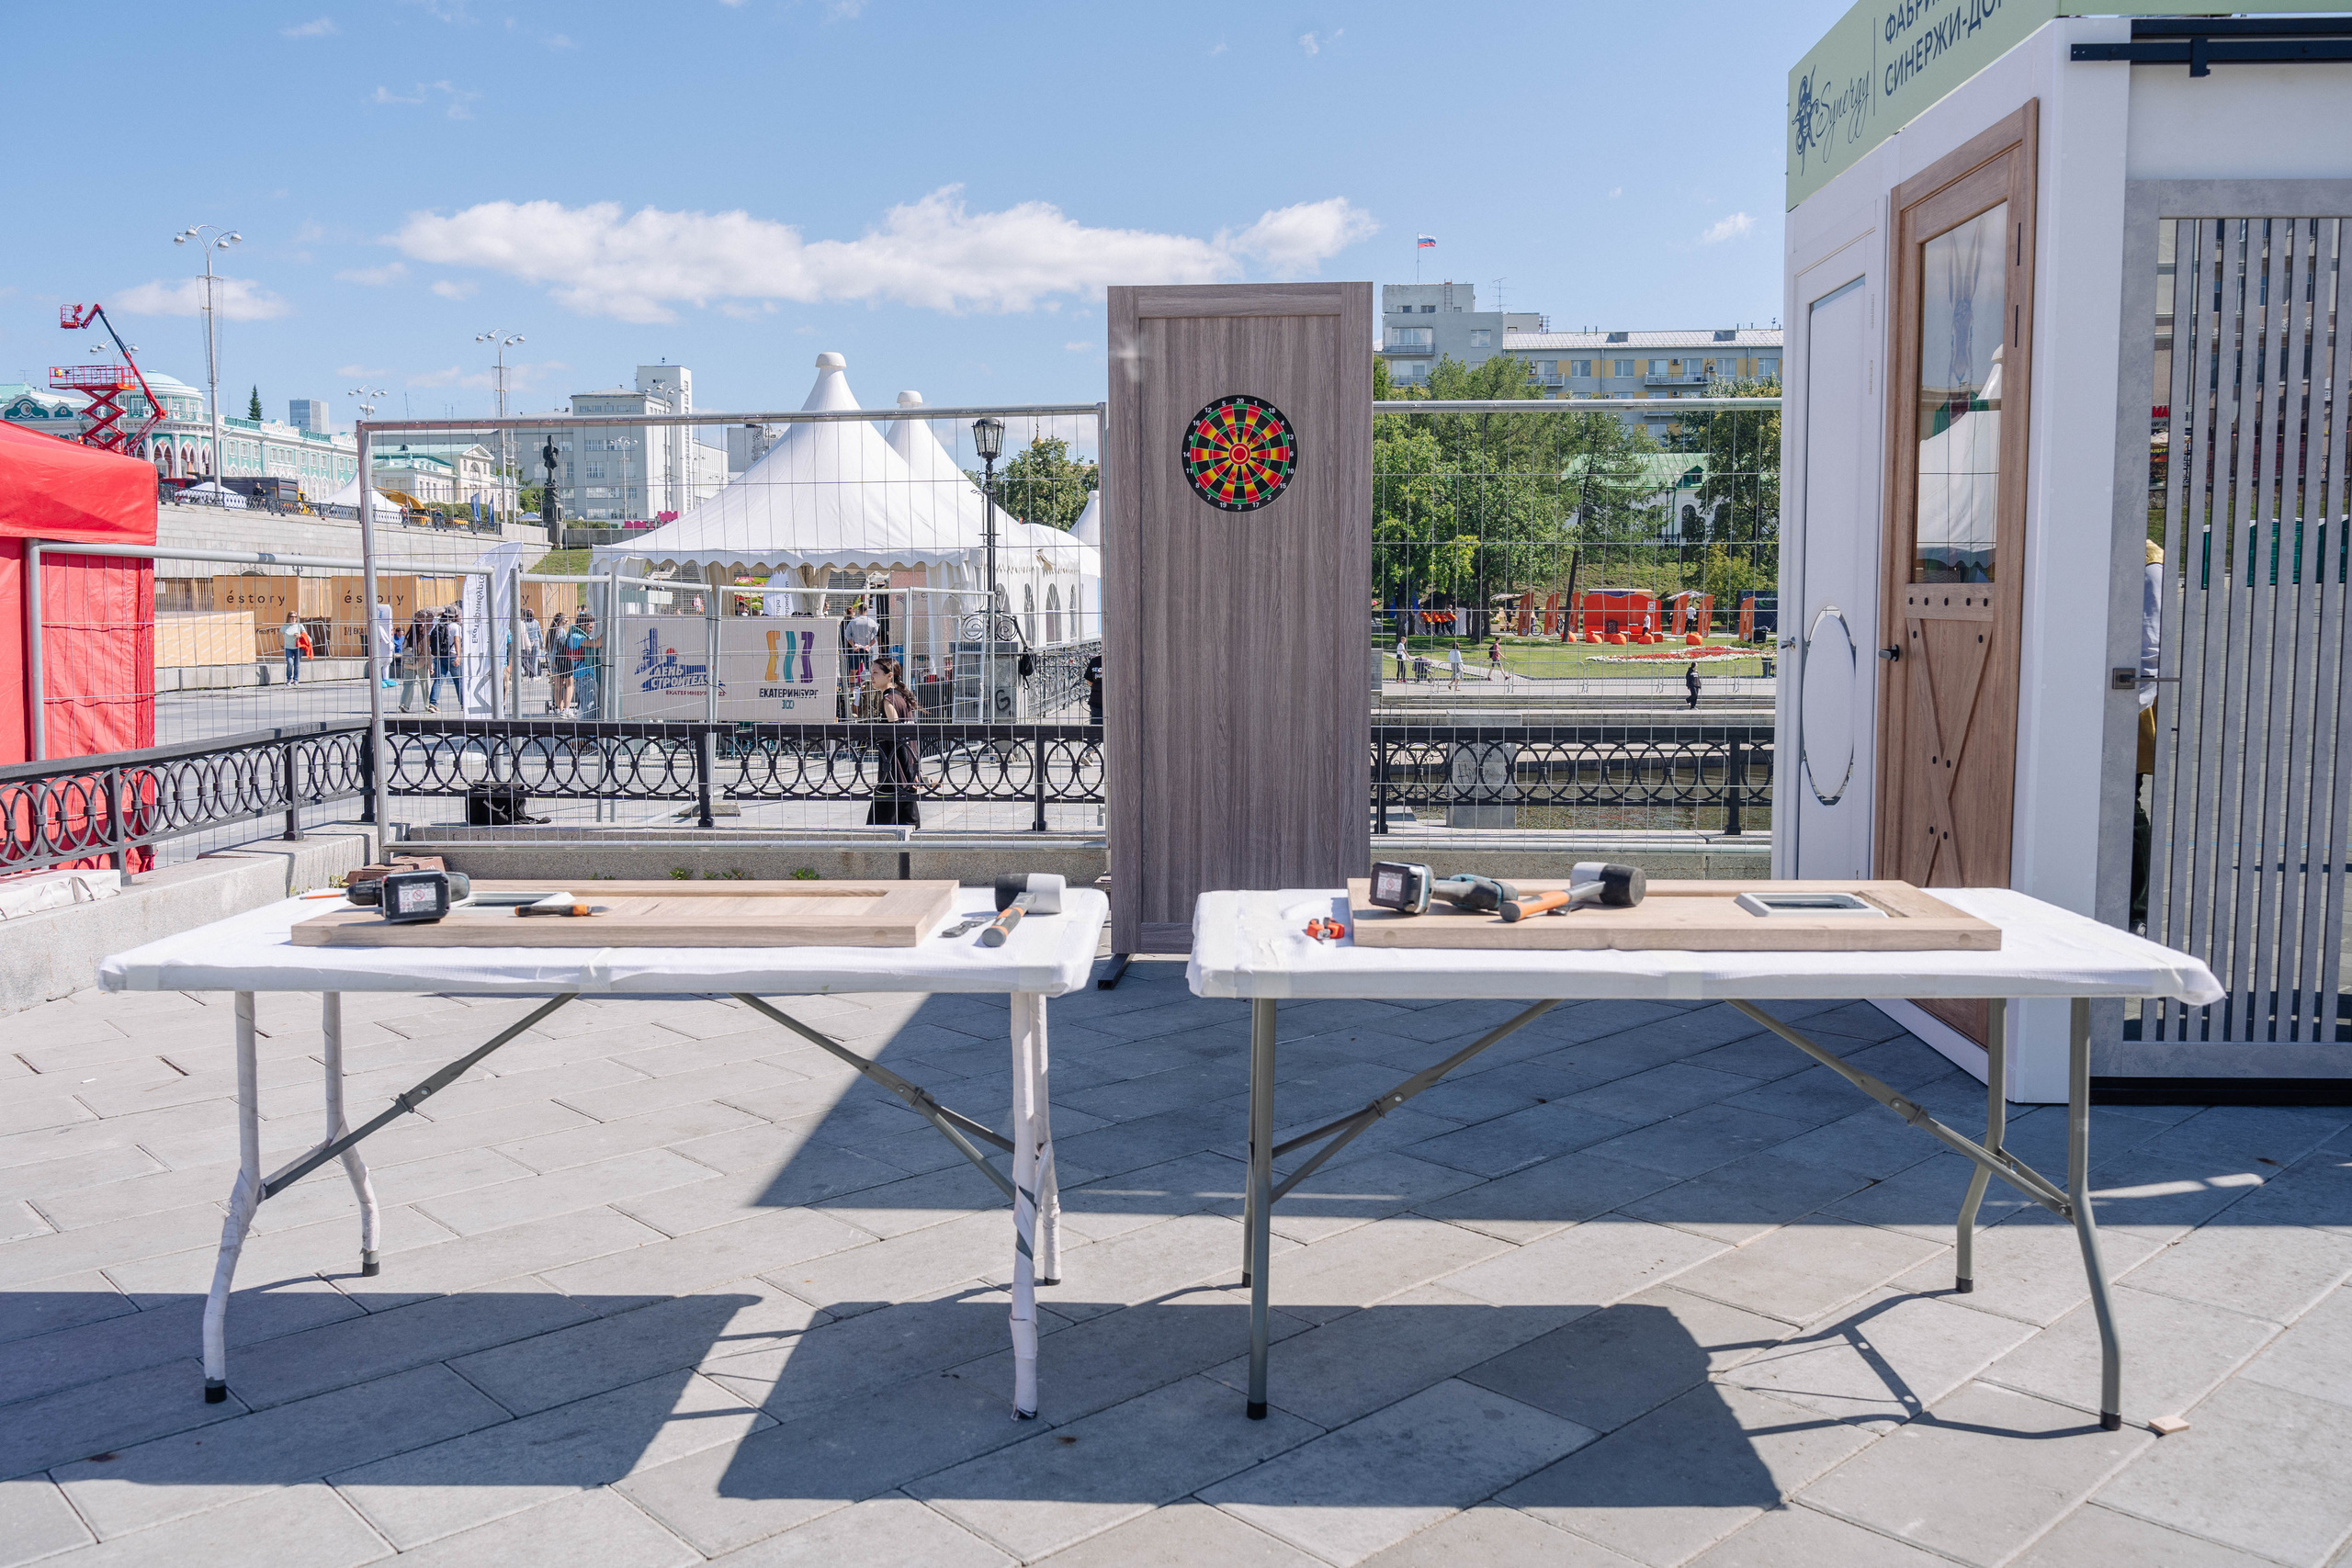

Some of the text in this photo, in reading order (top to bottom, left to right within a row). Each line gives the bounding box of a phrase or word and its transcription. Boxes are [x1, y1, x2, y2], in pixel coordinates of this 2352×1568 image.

[1884, 0, 1940, 44] ФАБР
[1884, 0, 2002, 96] СИНЕРЖИ-ДО
[1815, 71, 1870, 164] Synergy
[226, 590, 285, 606] éstory
[344, 589, 404, 606] ésory
[650, 674, 707, 690] СТРОИТЕЛ
[759, 688, 819, 699] ЕКАТЕРИНБУРГ
[781, 699, 795, 709] 300
